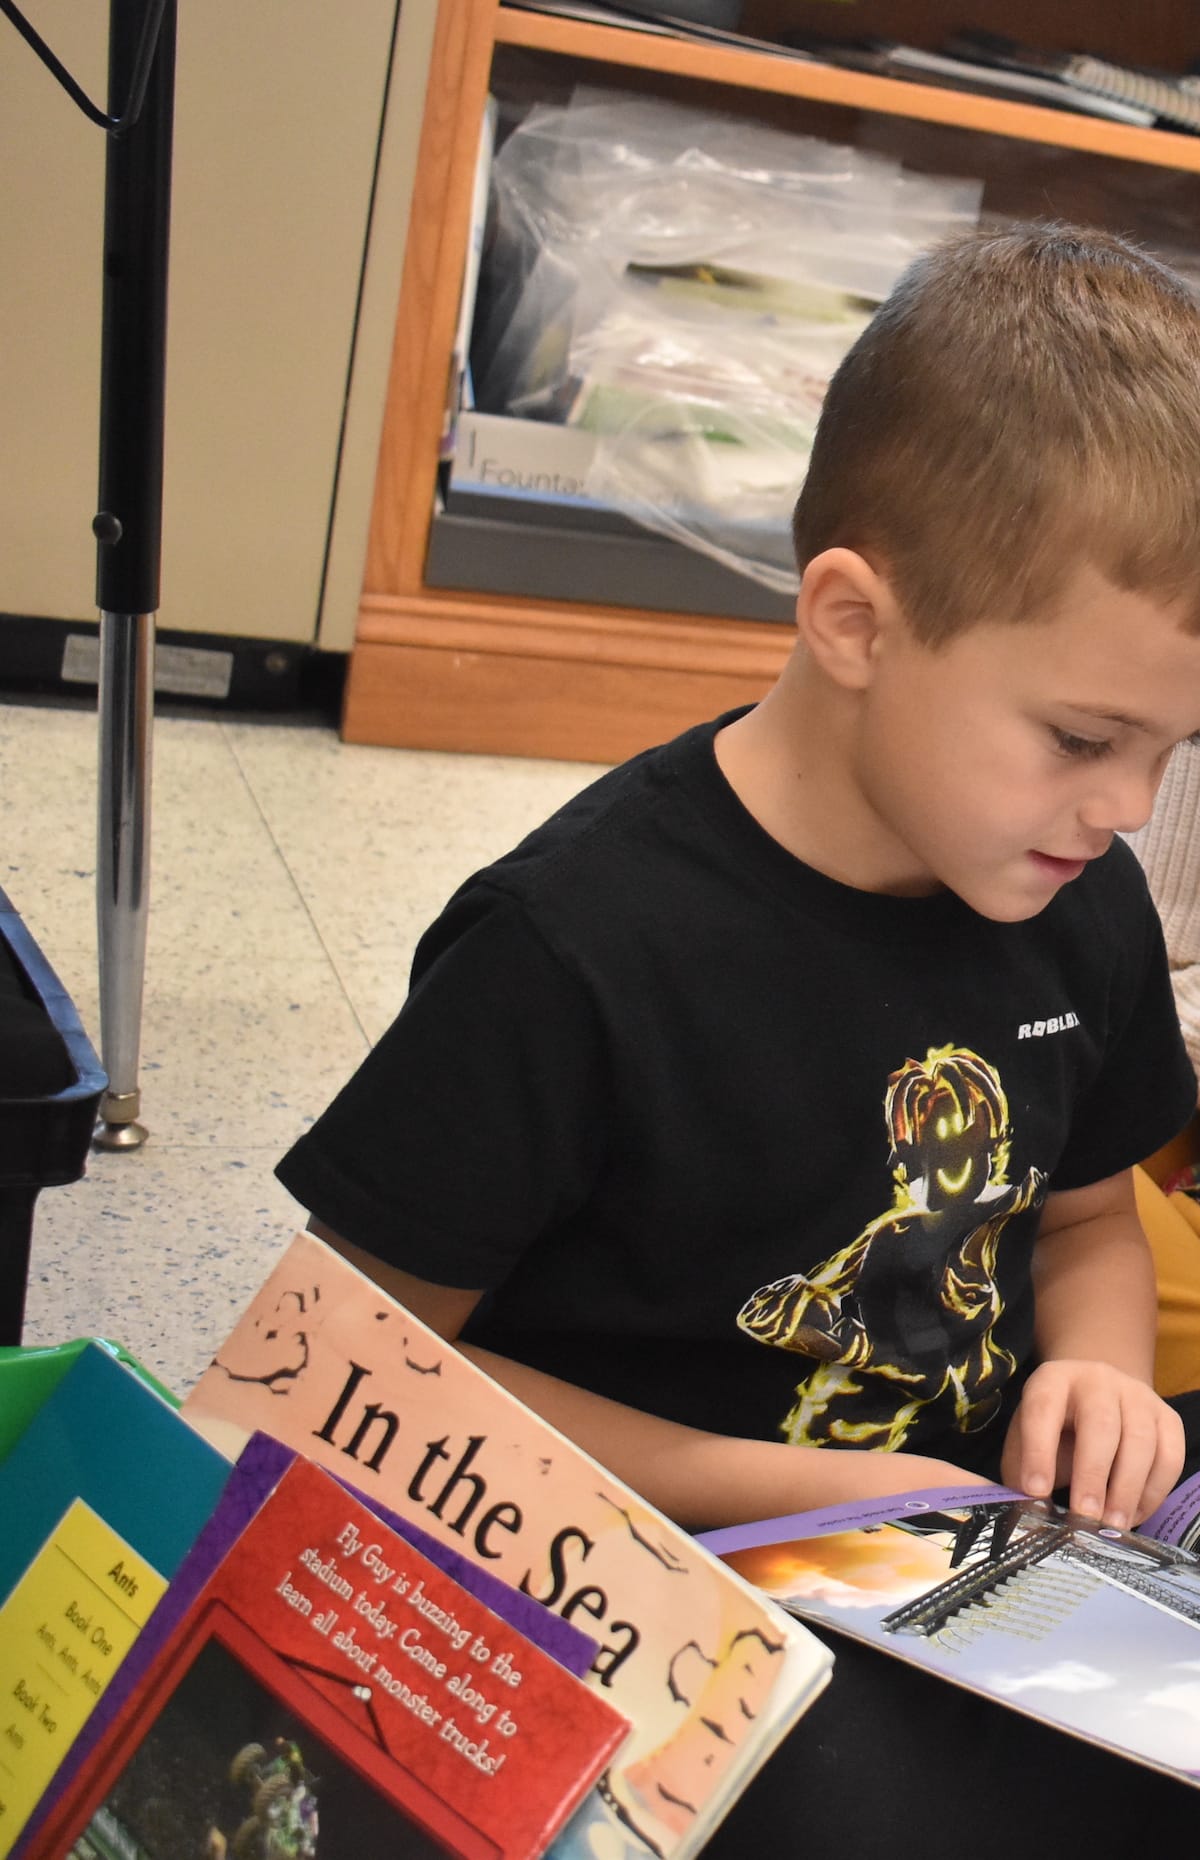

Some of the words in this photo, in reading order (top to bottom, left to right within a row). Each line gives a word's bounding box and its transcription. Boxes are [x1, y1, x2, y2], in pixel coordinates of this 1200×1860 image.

[480, 458, 590, 498] Founta
[107, 1560, 140, 1599] Ants
[312, 1360, 400, 1474] In
[407, 1435, 522, 1559] the
[519, 1526, 641, 1688] Sea
[64, 1600, 90, 1634] Book
[90, 1626, 113, 1657] One
[300, 1547, 355, 1601] stadium
[353, 1591, 398, 1640] today.
[399, 1627, 448, 1678] Come
[446, 1673, 499, 1724] along
[495, 1709, 518, 1737] to
[337, 1521, 363, 1557] Fly
[361, 1544, 396, 1585] Guy
[392, 1572, 411, 1595] is
[407, 1581, 472, 1650] buzzing
[469, 1636, 491, 1663] to
[489, 1652, 523, 1688] the
[12, 1679, 39, 1713] Book
[35, 1704, 57, 1734] Two
[275, 1571, 314, 1617] learn
[310, 1610, 339, 1636] all
[331, 1627, 378, 1674] about
[373, 1664, 443, 1728] monster
[438, 1717, 507, 1776] trucks!
